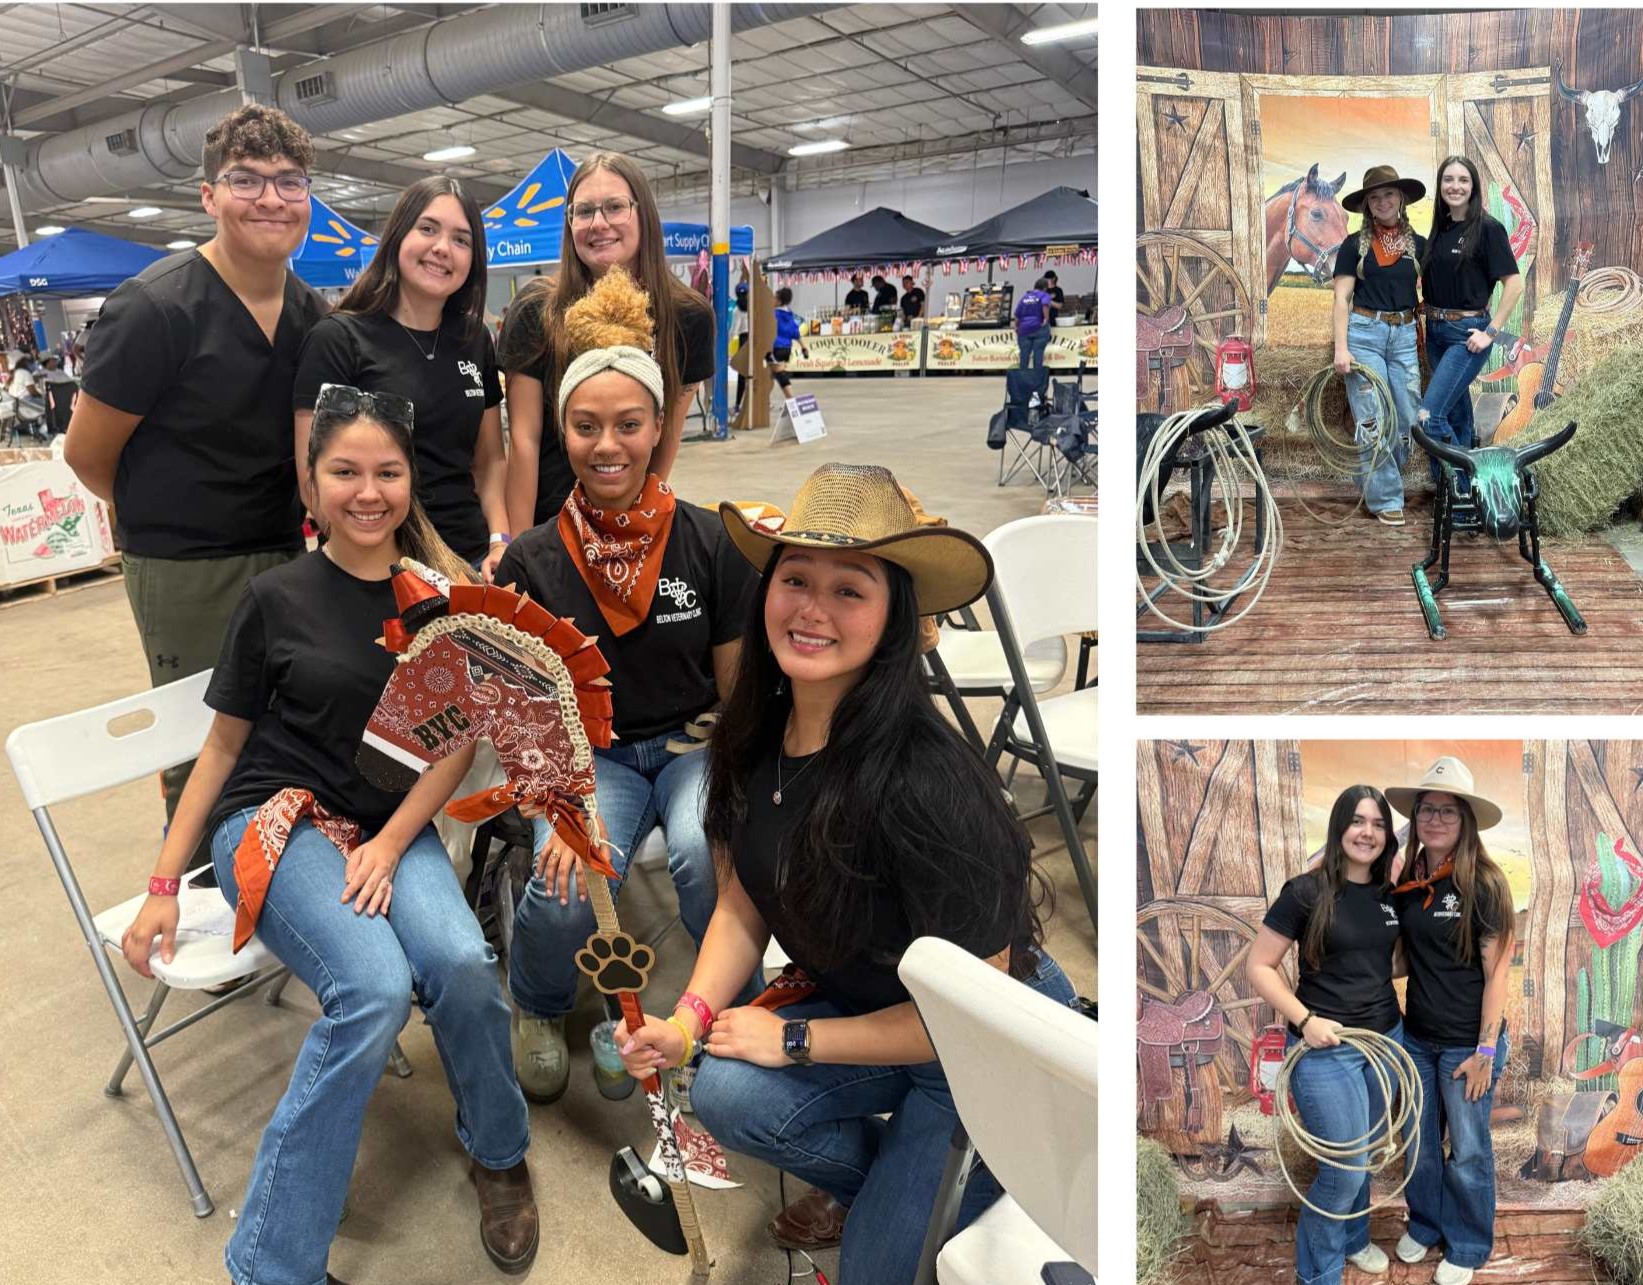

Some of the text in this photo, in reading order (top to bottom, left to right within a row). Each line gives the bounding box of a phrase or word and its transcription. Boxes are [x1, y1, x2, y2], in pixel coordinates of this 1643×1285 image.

[497, 240, 532, 257] Chain
[675, 233, 700, 251] Supply
[3, 504, 34, 517] Texas
[656, 613, 672, 624] BELTON
[412, 704, 471, 752] BVC
